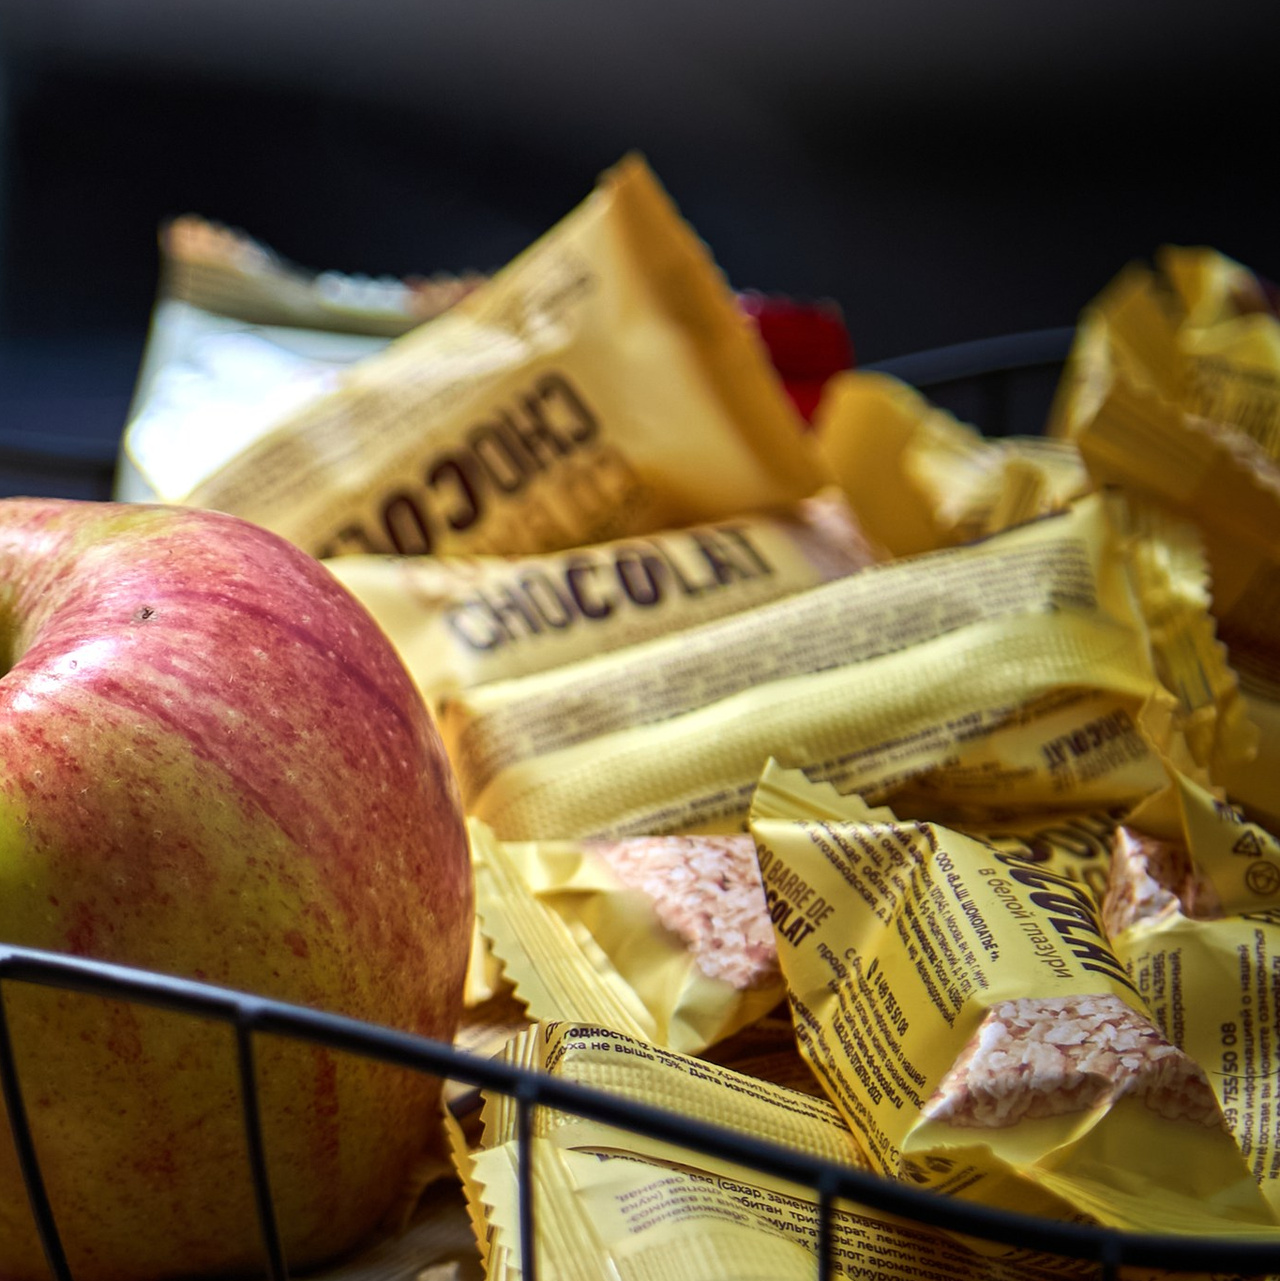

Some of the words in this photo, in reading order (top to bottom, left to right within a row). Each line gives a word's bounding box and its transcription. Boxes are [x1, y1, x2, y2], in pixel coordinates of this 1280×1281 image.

[310, 359, 608, 610] CHOCO
[445, 523, 775, 653] CHOCOLAT
[762, 857, 819, 910] BARRE
[801, 895, 838, 928] DE
[976, 861, 996, 878] в
[761, 879, 817, 949] COLAT
[878, 836, 912, 873] округ
[955, 971, 966, 981] 9
[934, 850, 952, 874] ООО
[959, 899, 997, 953] ШОКОЛАТЬЕ
[985, 870, 1036, 926] белой
[1018, 916, 1075, 988] глазури
[1153, 949, 1166, 1000] 143985,
[1236, 943, 1251, 991] нашей
[1253, 928, 1270, 1021] ознакомиться
[1139, 966, 1149, 991] стр.
[1167, 947, 1184, 1050] нодорожный,
[1241, 994, 1251, 1004] о
[887, 1007, 905, 1025] 50
[893, 1018, 912, 1037] 08
[1220, 1021, 1237, 1046] 08
[589, 1036, 613, 1053] не
[612, 1041, 658, 1064] выше
[657, 1054, 689, 1075] 75%.
[687, 1065, 722, 1086] Дата
[898, 1056, 930, 1089] нашей
[1222, 1051, 1237, 1072] 50
[1239, 1008, 1255, 1109] информацией
[1258, 1026, 1271, 1078] можете
[883, 1059, 927, 1111] ознакомитьс
[1222, 1076, 1238, 1103] 755
[1259, 1082, 1270, 1098] вы
[1258, 1102, 1271, 1144] составе
[715, 1177, 767, 1201] (сахар,
[765, 1192, 849, 1222] замениль
[762, 1215, 855, 1247] мульгары:
[856, 1240, 916, 1264] лецитин
[786, 1210, 872, 1240] трисарат,
[875, 1233, 936, 1257] лецитин
